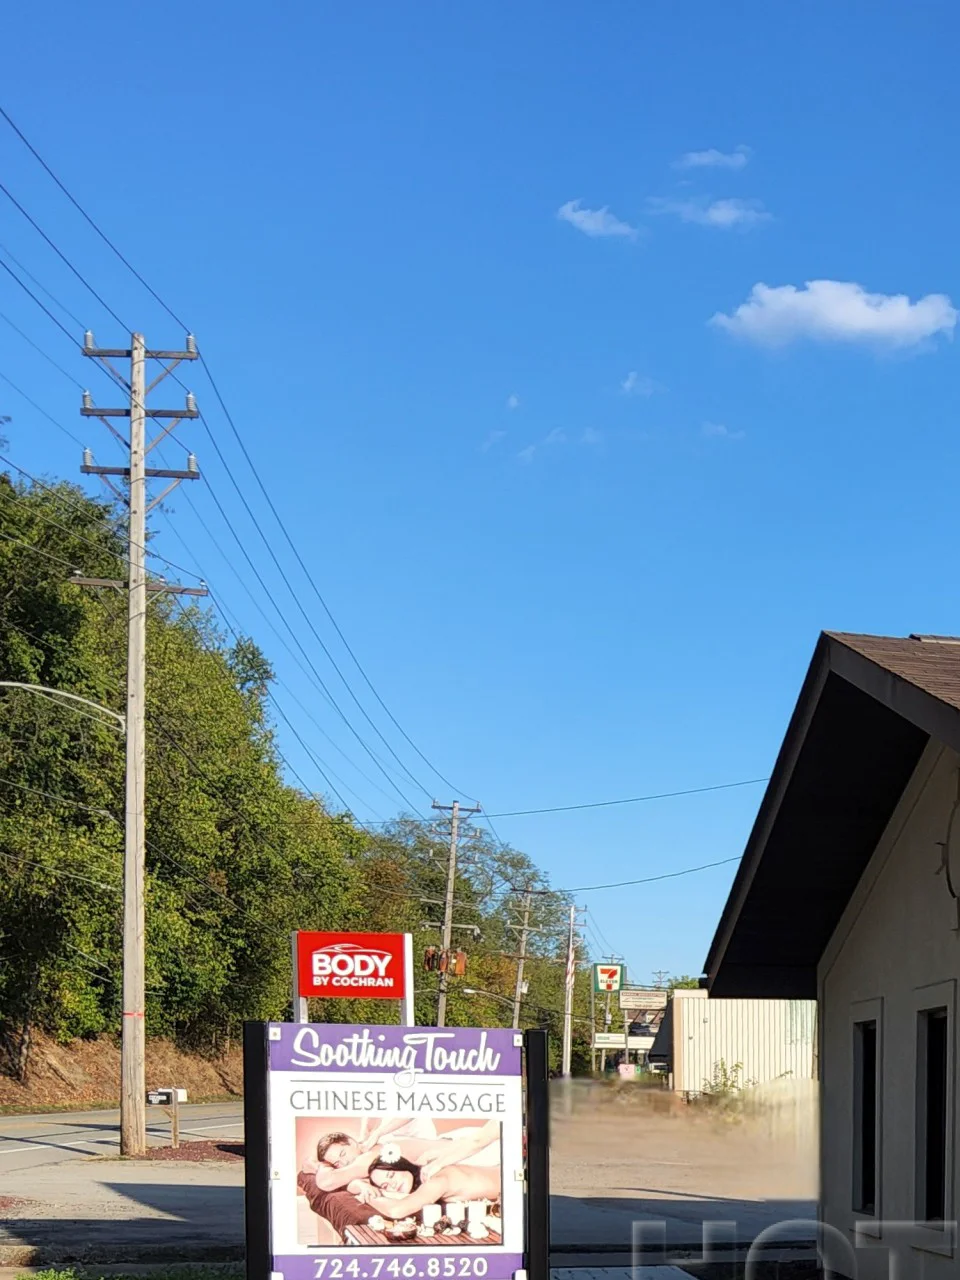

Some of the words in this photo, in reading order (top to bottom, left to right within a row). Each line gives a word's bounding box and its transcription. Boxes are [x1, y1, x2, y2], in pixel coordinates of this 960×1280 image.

[312, 953, 392, 976] BODY
[313, 976, 329, 986] BY
[332, 977, 394, 987] COCHRAN
[291, 1028, 424, 1087] Soothing
[403, 1031, 501, 1072] Touch
[290, 1090, 387, 1111] CHINESE
[396, 1091, 506, 1113] MASSAGE
[313, 1257, 488, 1278] 724.746.8520
